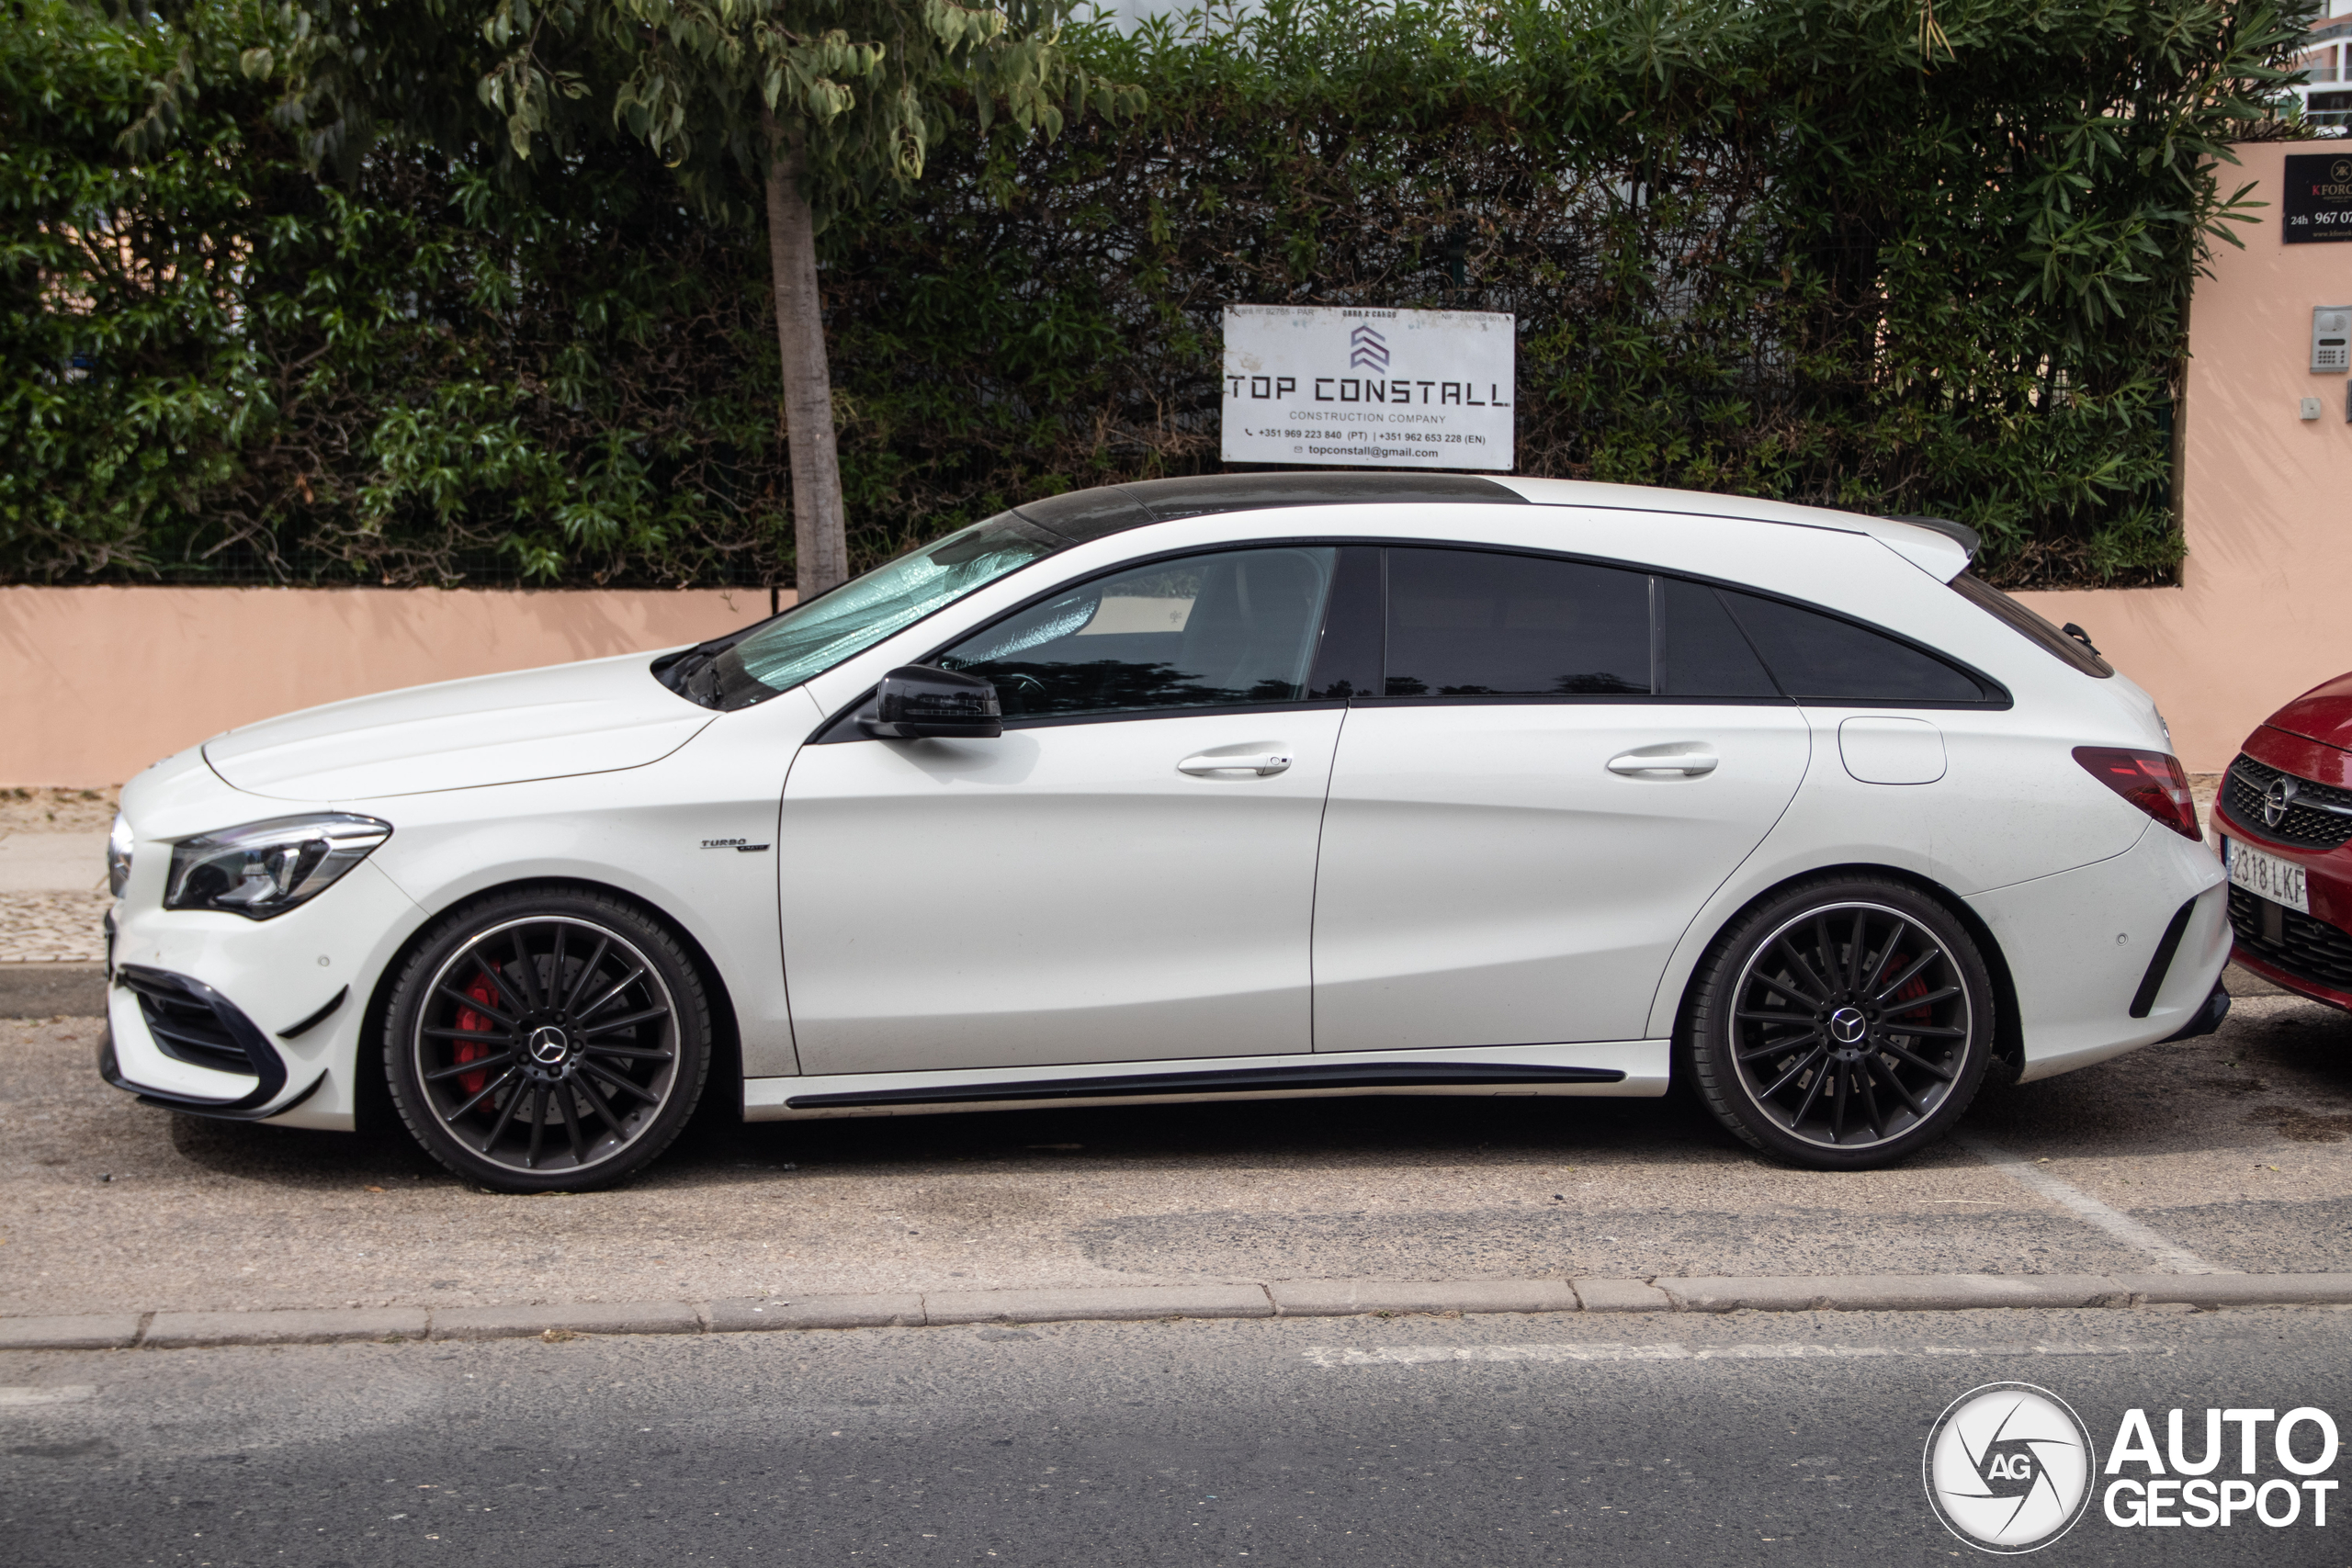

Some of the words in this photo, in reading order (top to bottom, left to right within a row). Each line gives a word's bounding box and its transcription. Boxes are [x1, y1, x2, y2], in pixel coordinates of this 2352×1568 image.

[2290, 214, 2309, 225] 24h
[2314, 211, 2338, 225] 967
[1297, 308, 1315, 317] PAR
[1227, 375, 1296, 400] TOP
[1315, 378, 1510, 408] CONSTALL
[1289, 411, 1385, 423] CONSTRUCTION
[1388, 413, 1446, 423] COMPANY
[1259, 428, 1282, 438] +351
[1284, 429, 1302, 438] 969
[1305, 430, 1322, 439] 223
[1324, 431, 1342, 439] 840
[1347, 431, 1368, 442] (PT)
[1379, 432, 1402, 441] +351
[1405, 433, 1422, 442] 962
[1424, 434, 1442, 443] 653
[1444, 434, 1462, 443] 228
[1464, 434, 1486, 446] (EN)
[1308, 445, 1439, 458] topconstall@gmail.com
[701, 839, 747, 847] TURBO
[2233, 846, 2267, 890] 2318
[2273, 862, 2305, 903] LKF
